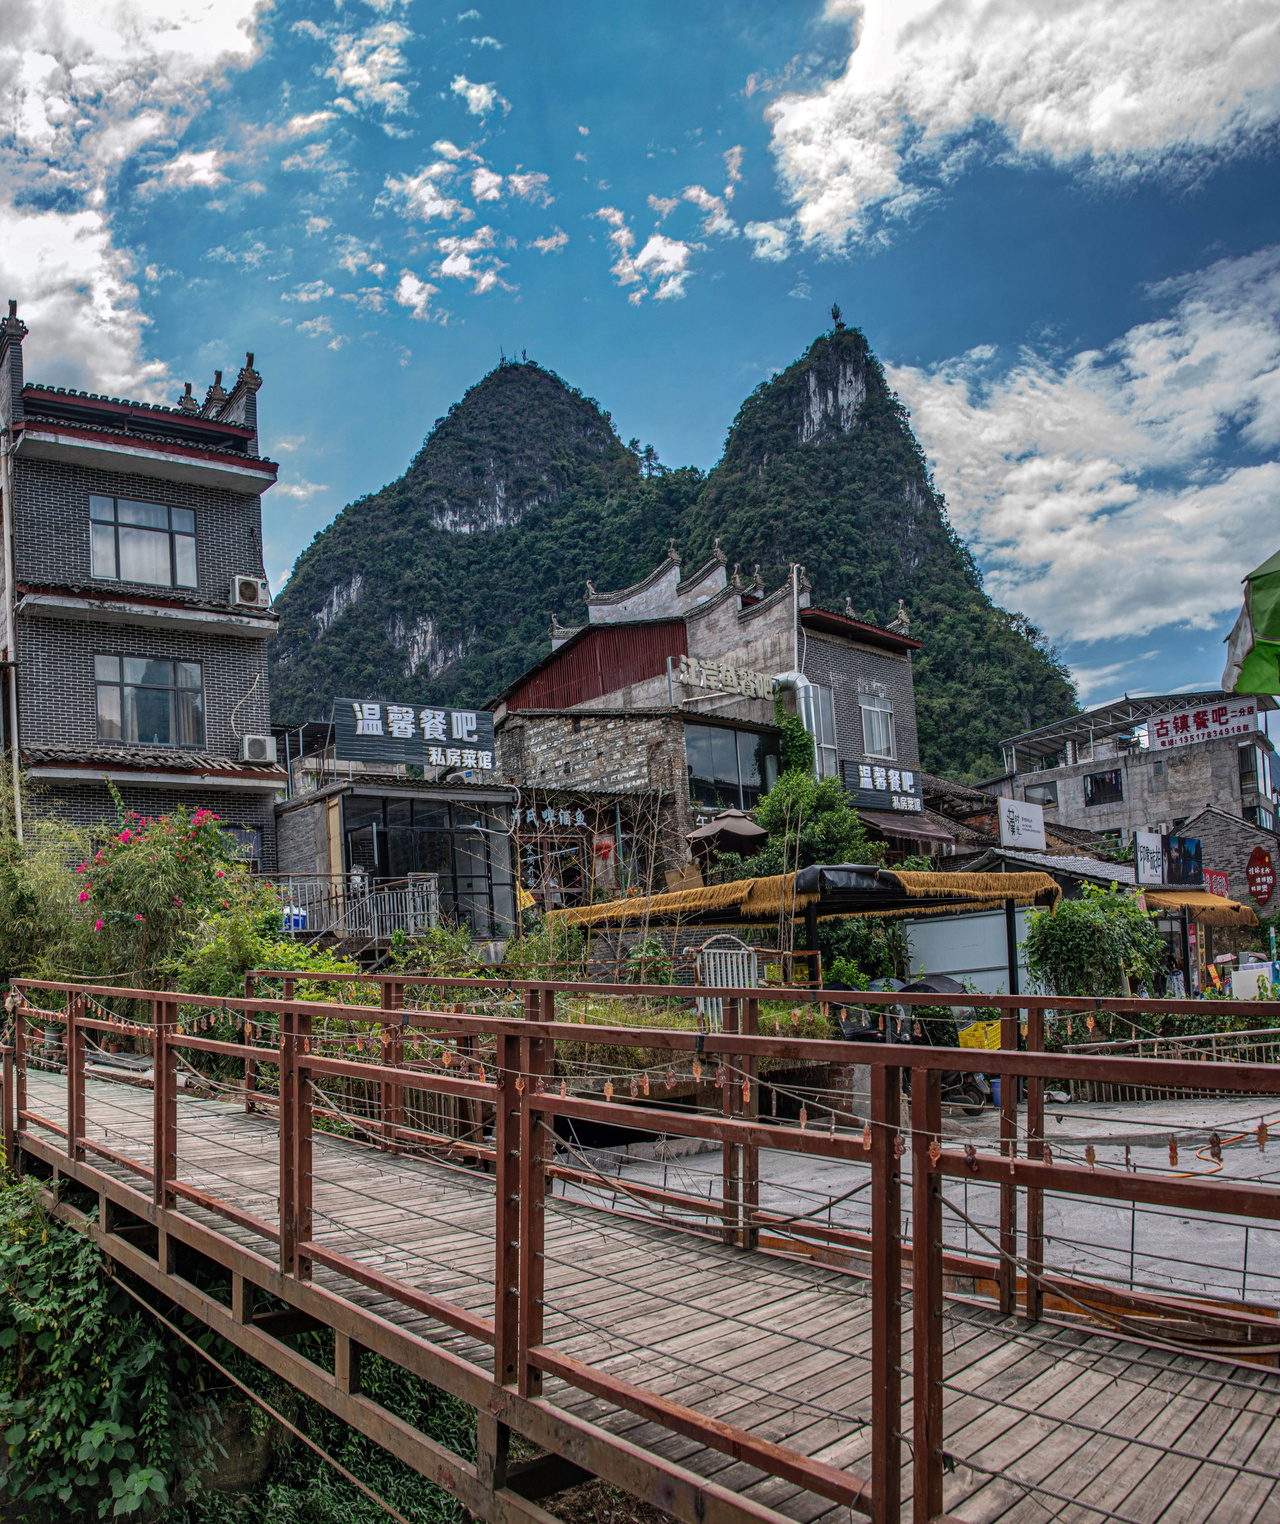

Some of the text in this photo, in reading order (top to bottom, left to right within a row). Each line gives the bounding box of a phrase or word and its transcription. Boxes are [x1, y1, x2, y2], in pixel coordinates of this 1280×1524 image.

[352, 703, 479, 742] 温馨餐吧
[1154, 706, 1255, 738] 古镇餐吧 二分店
[428, 747, 492, 769] 私房菜馆
[858, 765, 915, 793] 温馨餐吧
[892, 796, 921, 811] 私房菜馆
